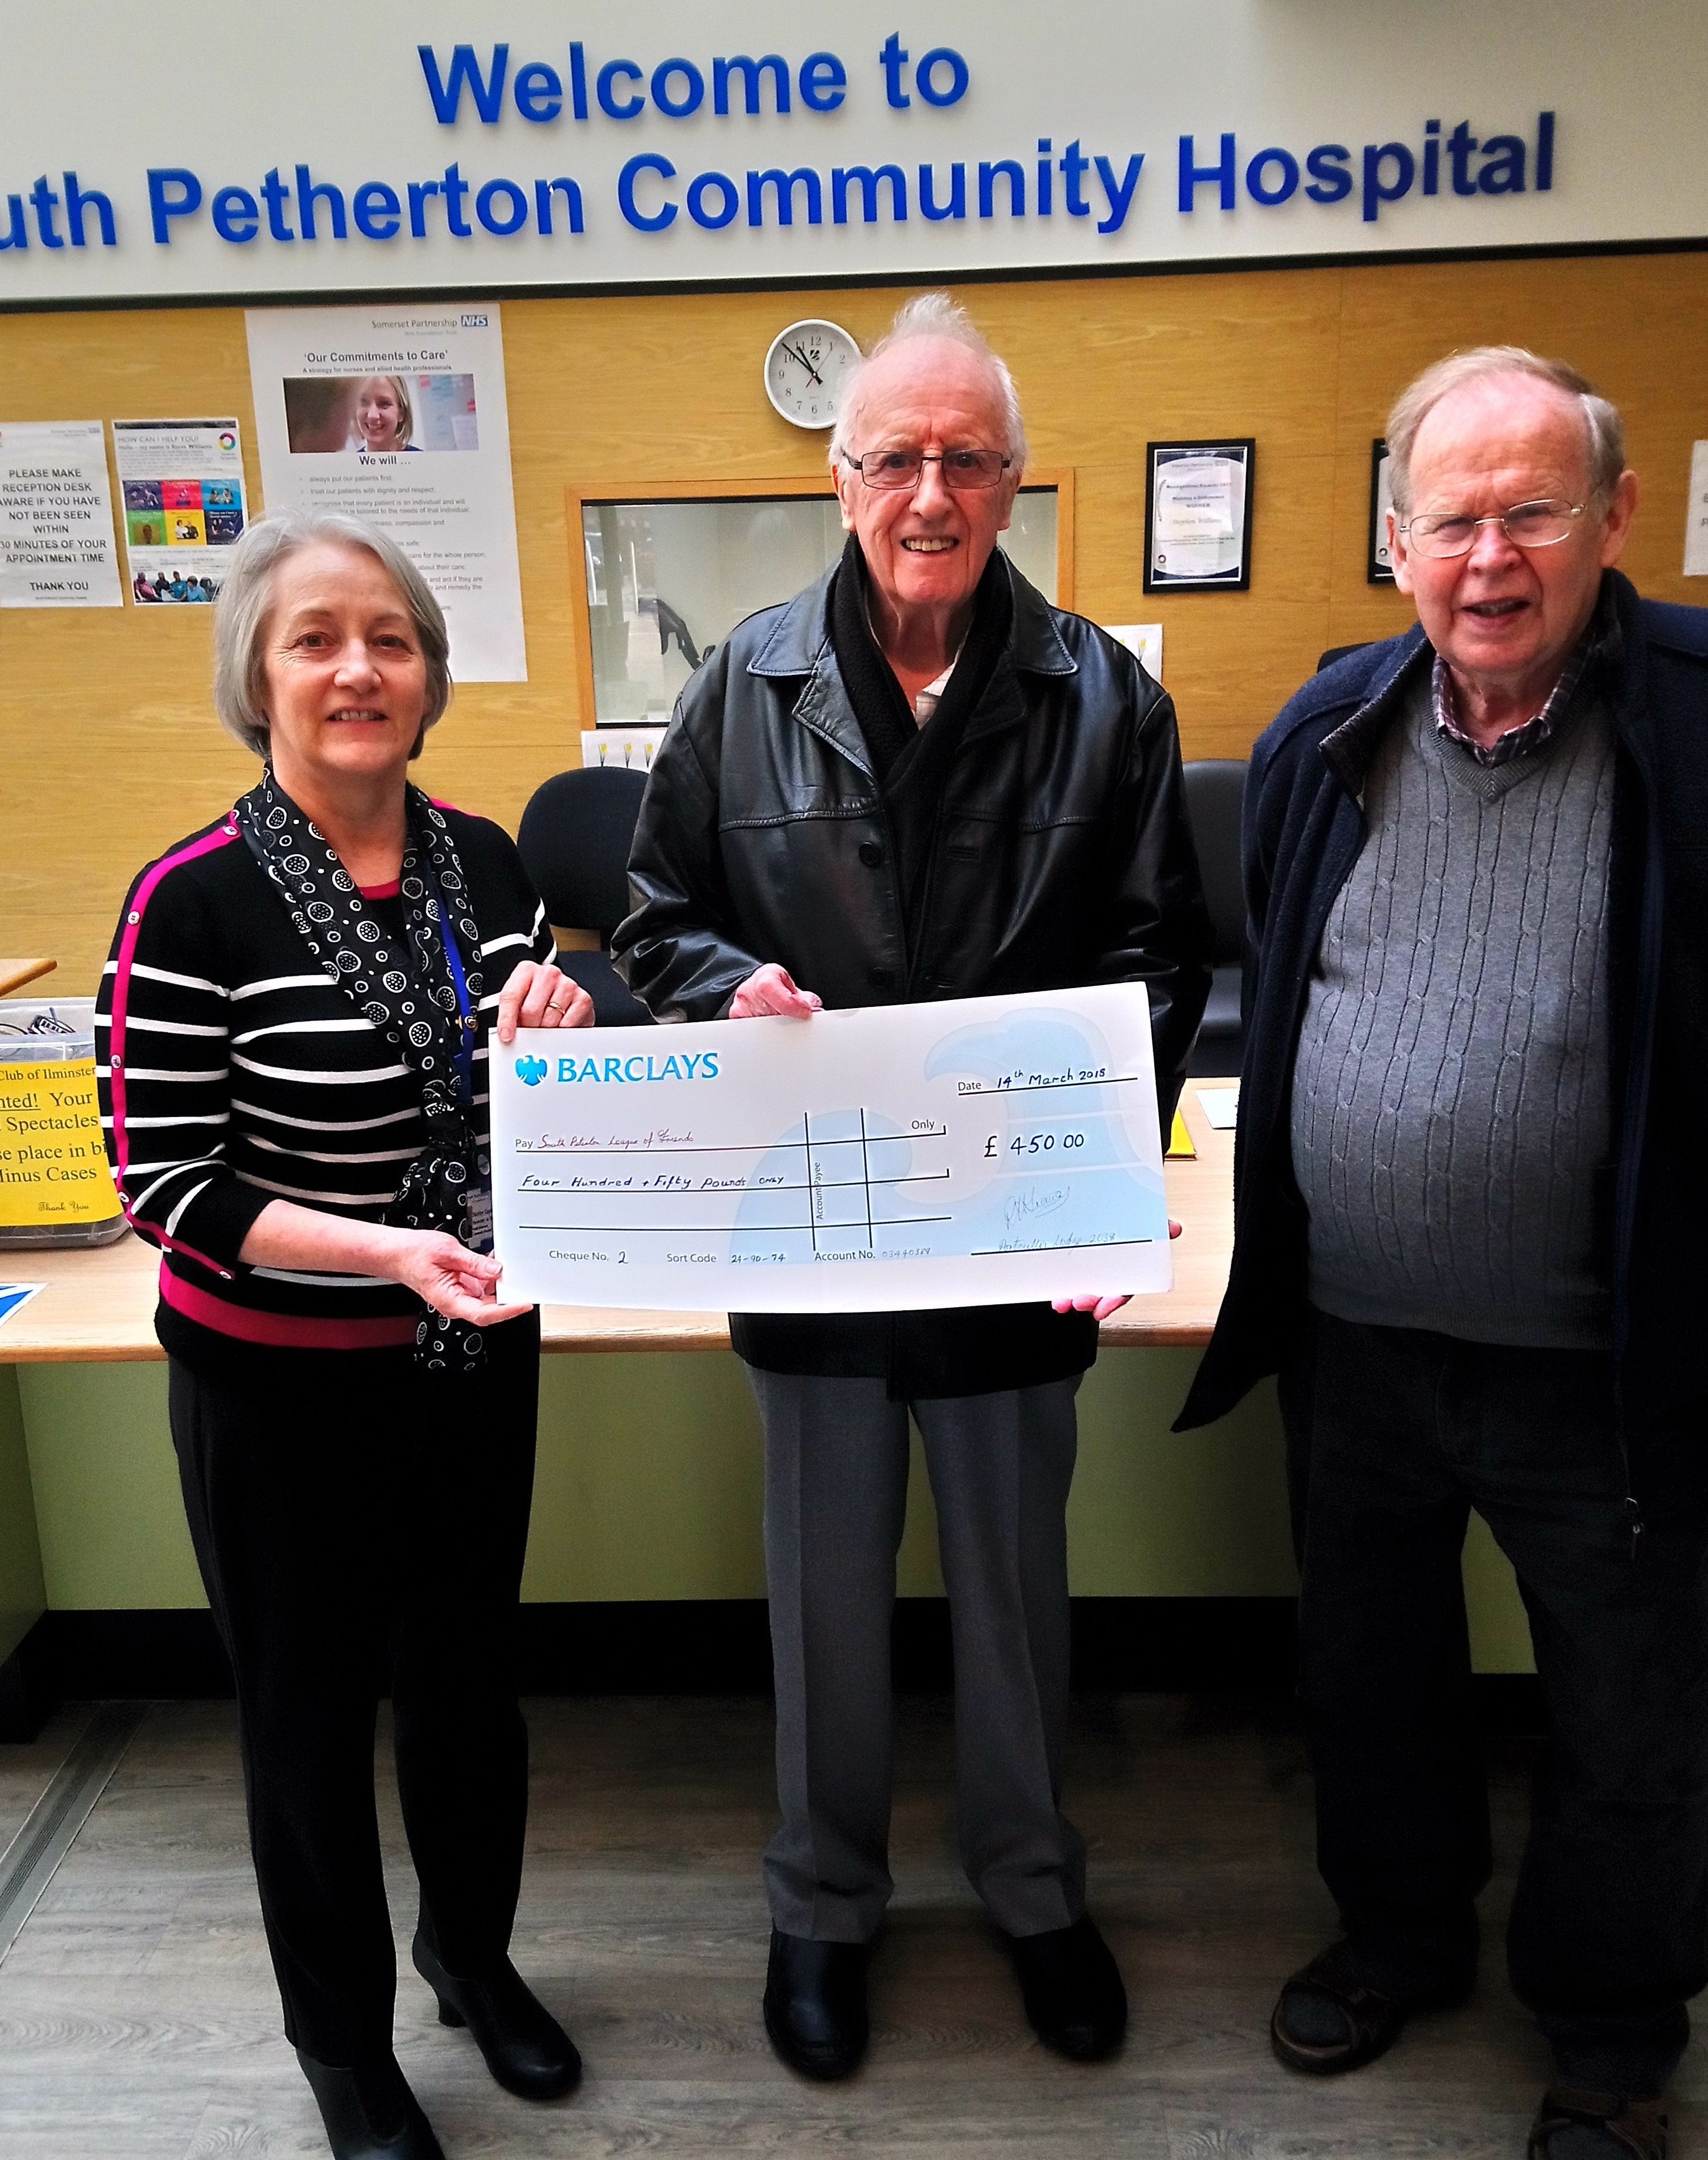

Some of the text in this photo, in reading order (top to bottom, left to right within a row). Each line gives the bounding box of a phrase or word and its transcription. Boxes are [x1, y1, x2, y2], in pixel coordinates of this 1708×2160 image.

[418, 31, 969, 123] Welcome to
[147, 161, 584, 244] Petherton
[618, 137, 1145, 233] Community
[1177, 111, 1556, 221] Hospital
[372, 315, 487, 328] Somerset Partnership NHS
[796, 341, 805, 350] 11
[810, 336, 821, 345] 12
[830, 342, 833, 351] 1
[330, 352, 403, 361] Commitments
[407, 351, 417, 360] to
[784, 354, 795, 363] 10
[840, 355, 845, 364] 2
[779, 370, 785, 379] 9
[786, 388, 792, 397] 8
[796, 401, 802, 410] 7
[812, 405, 817, 414] 6
[828, 401, 833, 410] 5
[360, 456, 397, 465] We will
[9, 468, 81, 478] PLEASE MAKE
[2, 483, 92, 492] RECEPTION DESK
[0, 497, 101, 506] AWARE IF YOU HAVE
[9, 510, 91, 520] NOT BEEN SEEN
[33, 525, 69, 534] WITHIN
[0, 539, 107, 549] 30 MINUTES OF YOUR
[6, 553, 105, 563] APPOINTMENT TIME
[458, 576, 471, 584] they
[29, 581, 89, 591] THANK YOU
[27, 1069, 41, 1080] of
[44, 1065, 96, 1079] Ilminster
[557, 1052, 719, 1084] BARCLAYS
[958, 1081, 982, 1091] Date
[1029, 1068, 1074, 1086] March
[1079, 1068, 1106, 1081] 2018
[49, 1091, 93, 1107] Your
[6, 1114, 99, 1135] Spectacles
[911, 1119, 935, 1131] Only
[515, 1138, 533, 1149] Pay
[643, 1131, 654, 1149] of
[983, 1134, 1084, 1158] £ 450 00
[18, 1145, 63, 1164] place
[69, 1143, 86, 1158] in
[92, 1139, 107, 1156] bi
[46, 1166, 98, 1182] Cases
[815, 1162, 823, 1186] Payee
[522, 1175, 560, 1187] Four
[571, 1176, 633, 1187] Hundred
[653, 1175, 692, 1191] Fifty
[758, 1175, 785, 1185] ONLY
[38, 1200, 89, 1213] Thank You
[549, 1250, 717, 1264] Cheque No. 2 Sort Code
[815, 1250, 876, 1261] Account No.
